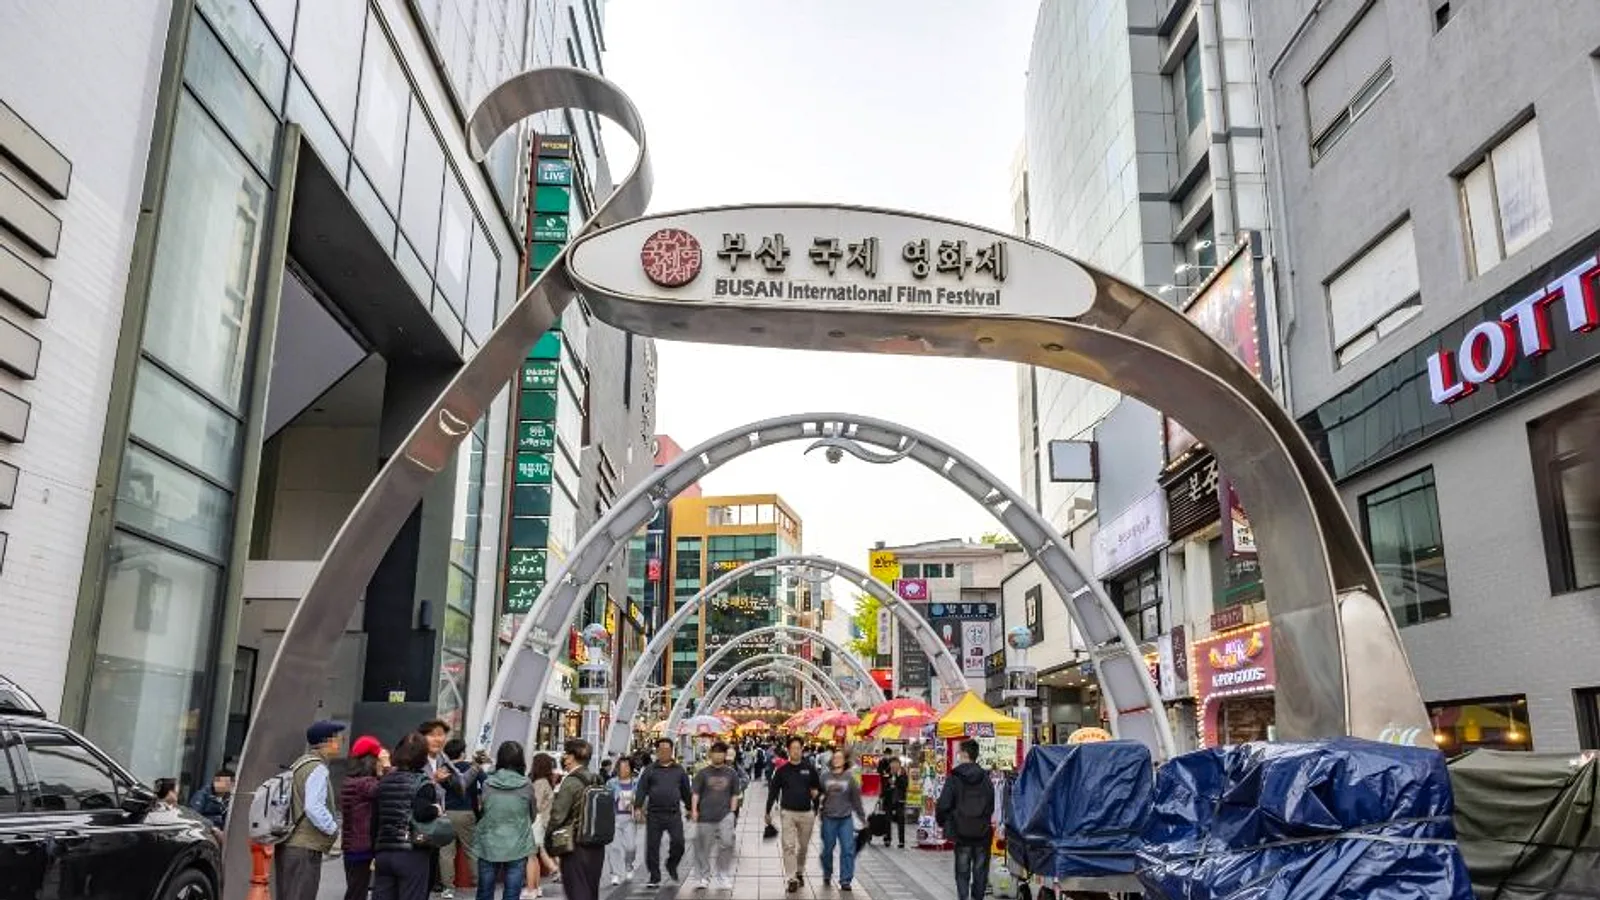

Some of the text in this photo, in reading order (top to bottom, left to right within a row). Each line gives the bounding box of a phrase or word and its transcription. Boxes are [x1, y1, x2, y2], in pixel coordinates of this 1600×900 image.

[544, 171, 564, 180] LIVE
[716, 232, 1009, 282] 부산 국제 영화제
[714, 278, 1001, 306] BUSAN International Film Festival
